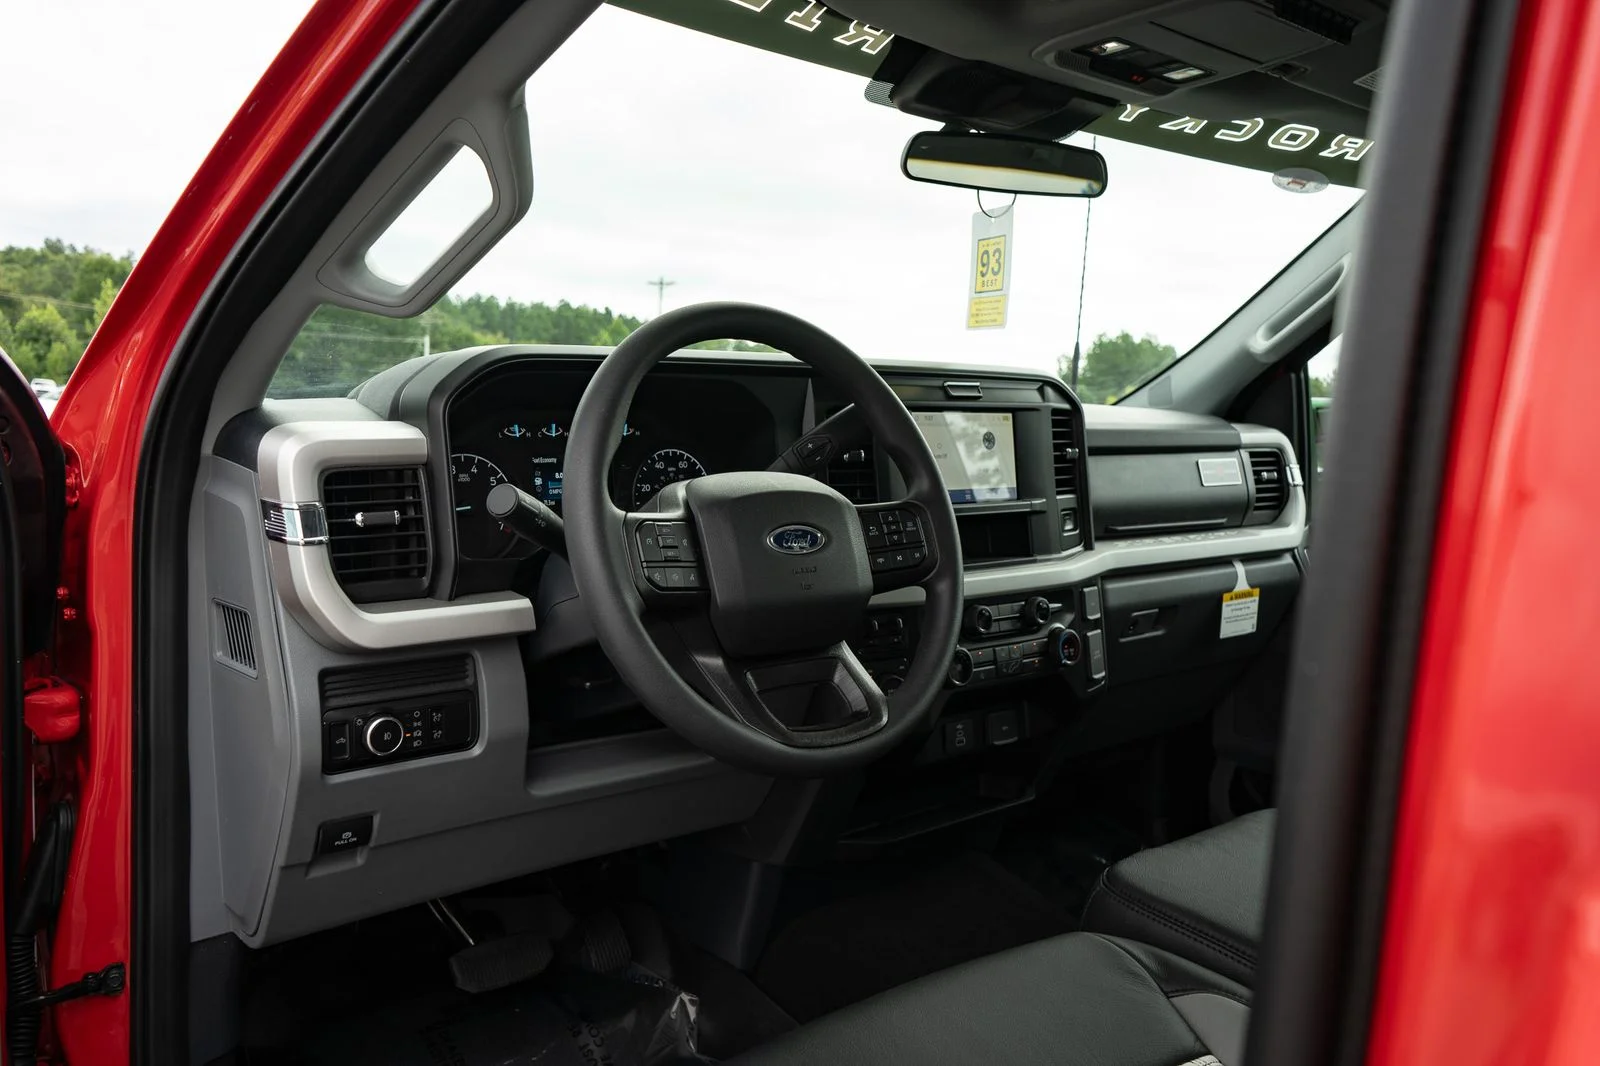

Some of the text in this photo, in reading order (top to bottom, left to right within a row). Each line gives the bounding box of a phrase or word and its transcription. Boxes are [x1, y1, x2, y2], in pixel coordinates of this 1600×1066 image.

[979, 247, 1003, 278] 93
[981, 278, 999, 288] BEST
[471, 465, 478, 474] 4
[654, 461, 665, 470] 40
[678, 461, 688, 469] 60
[489, 477, 497, 486] 5
[640, 484, 651, 492] 20
[782, 530, 812, 549] Ford
